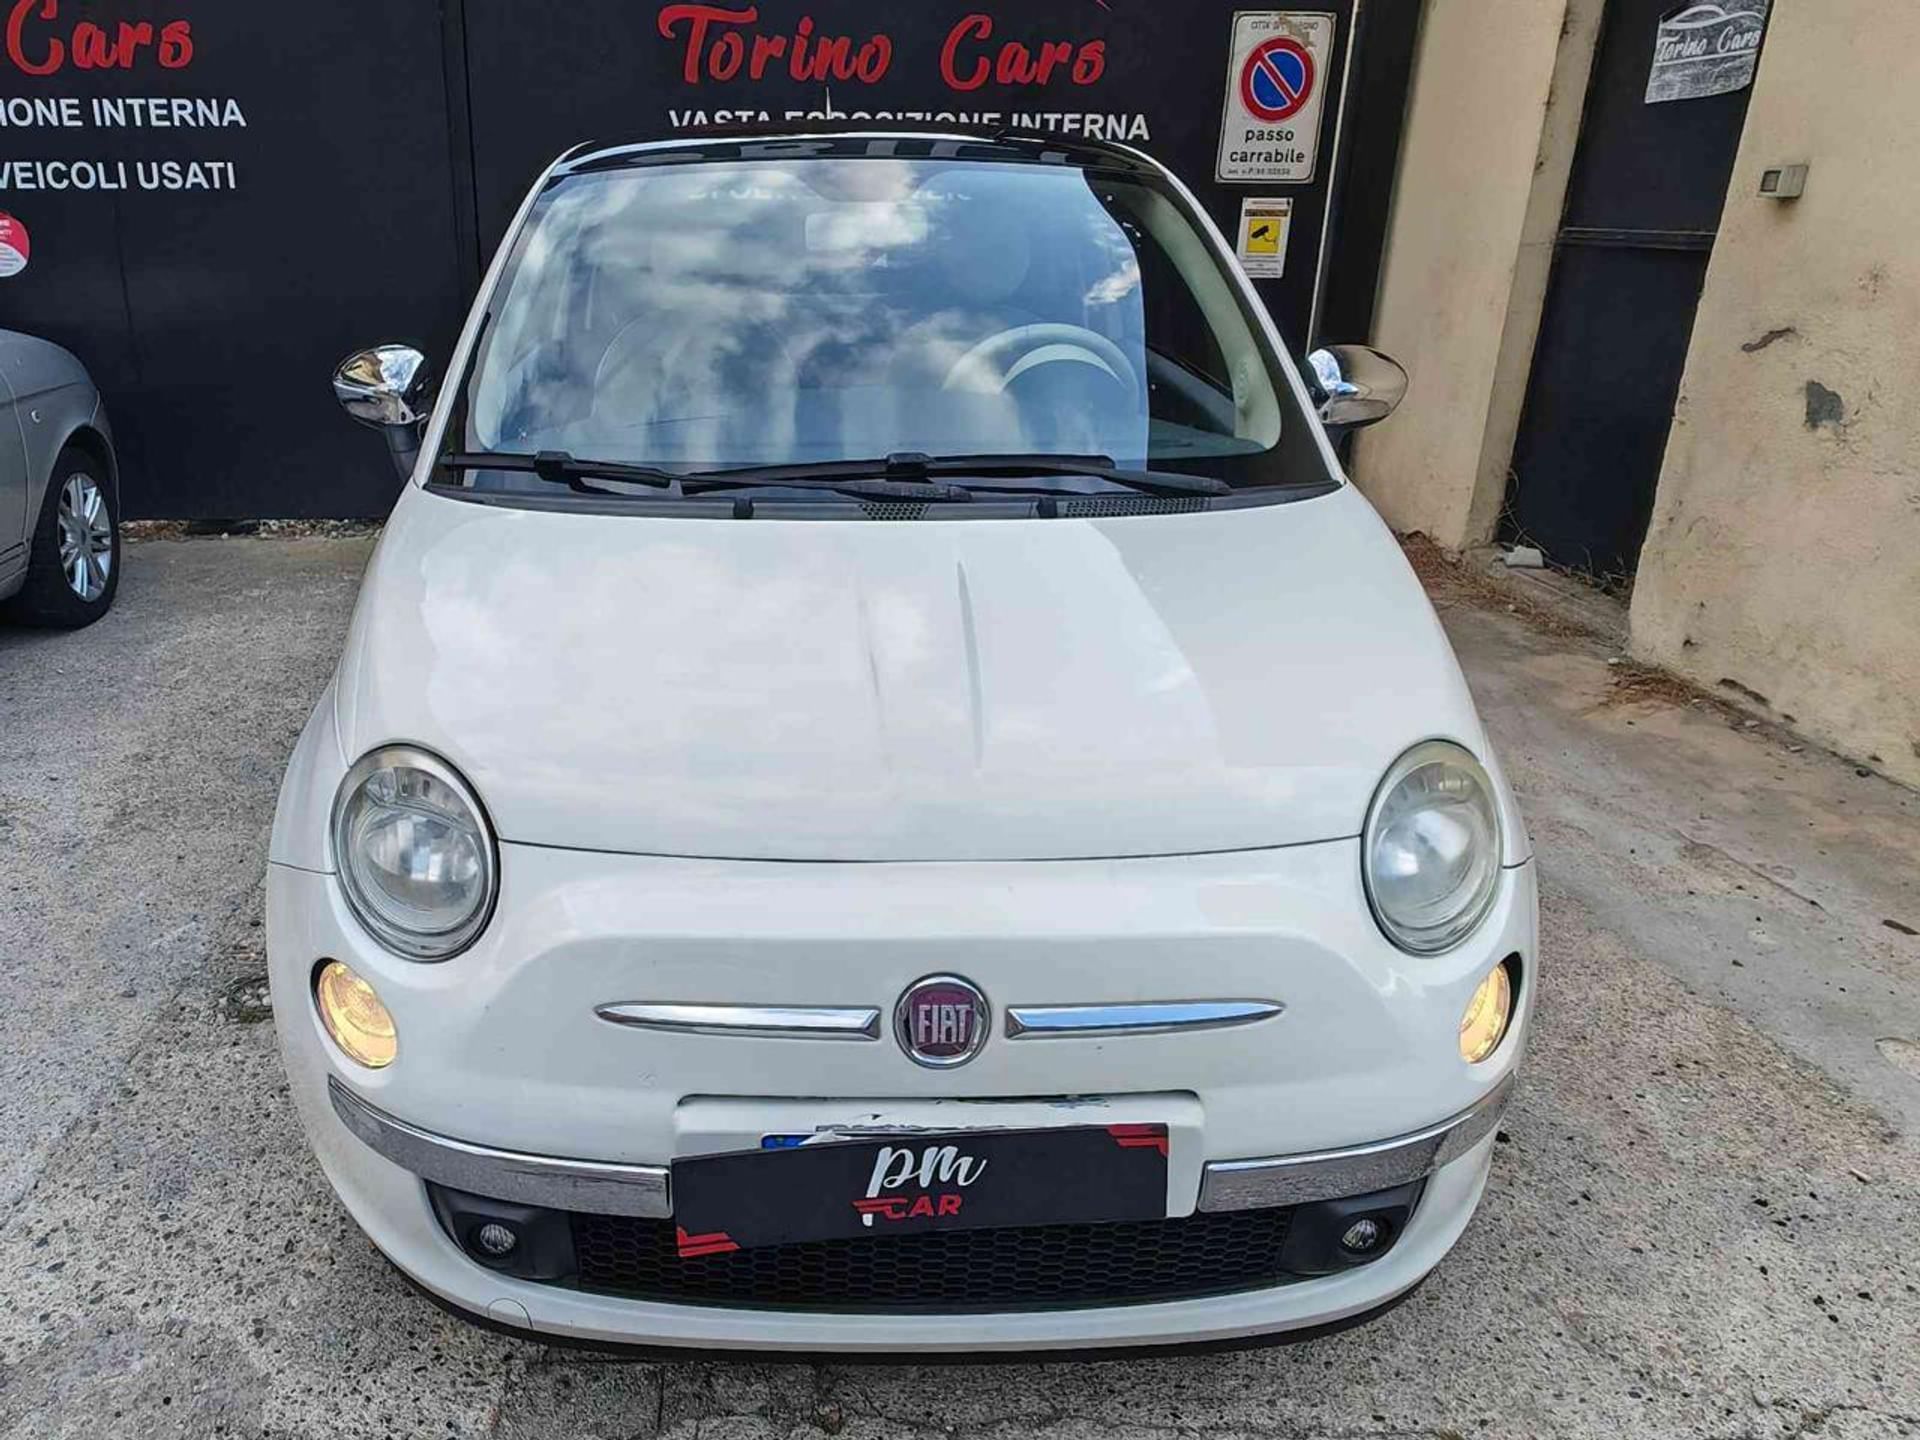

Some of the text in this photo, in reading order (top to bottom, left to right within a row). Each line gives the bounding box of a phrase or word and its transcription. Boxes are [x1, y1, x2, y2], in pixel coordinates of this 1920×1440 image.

[6, 0, 195, 75] Cars
[658, 4, 1106, 90] Torino Cars
[92, 97, 248, 128] INTERNA
[1244, 129, 1295, 143] passo
[1229, 147, 1305, 163] carrabile
[137, 160, 237, 190] USATI
[918, 1004, 971, 1044] FIAT
[876, 1194, 962, 1219] CAR
